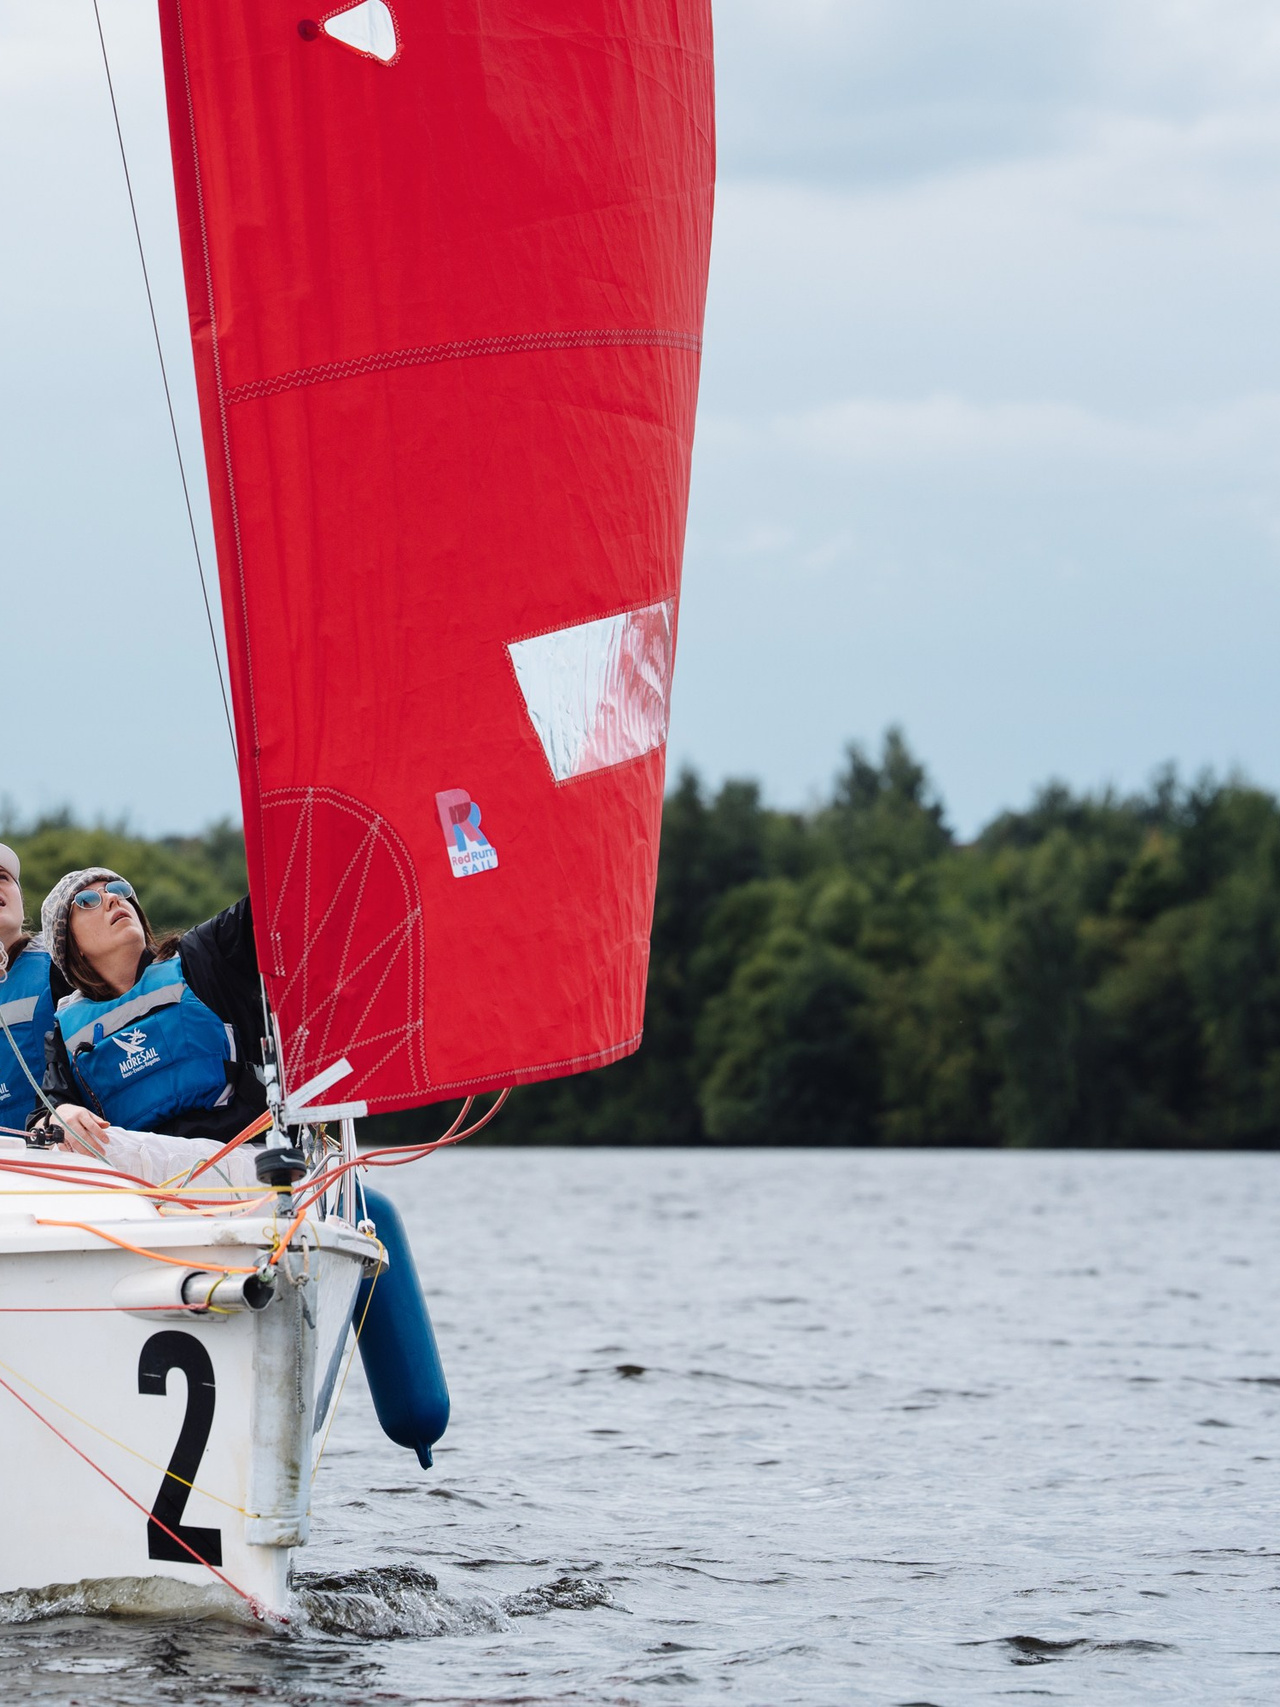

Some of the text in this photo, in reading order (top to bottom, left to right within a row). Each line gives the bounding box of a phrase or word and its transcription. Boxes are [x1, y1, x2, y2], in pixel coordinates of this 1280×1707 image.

[462, 859, 493, 876] SAIL
[119, 1047, 159, 1074] MORESAIL
[138, 1330, 223, 1567] 2
